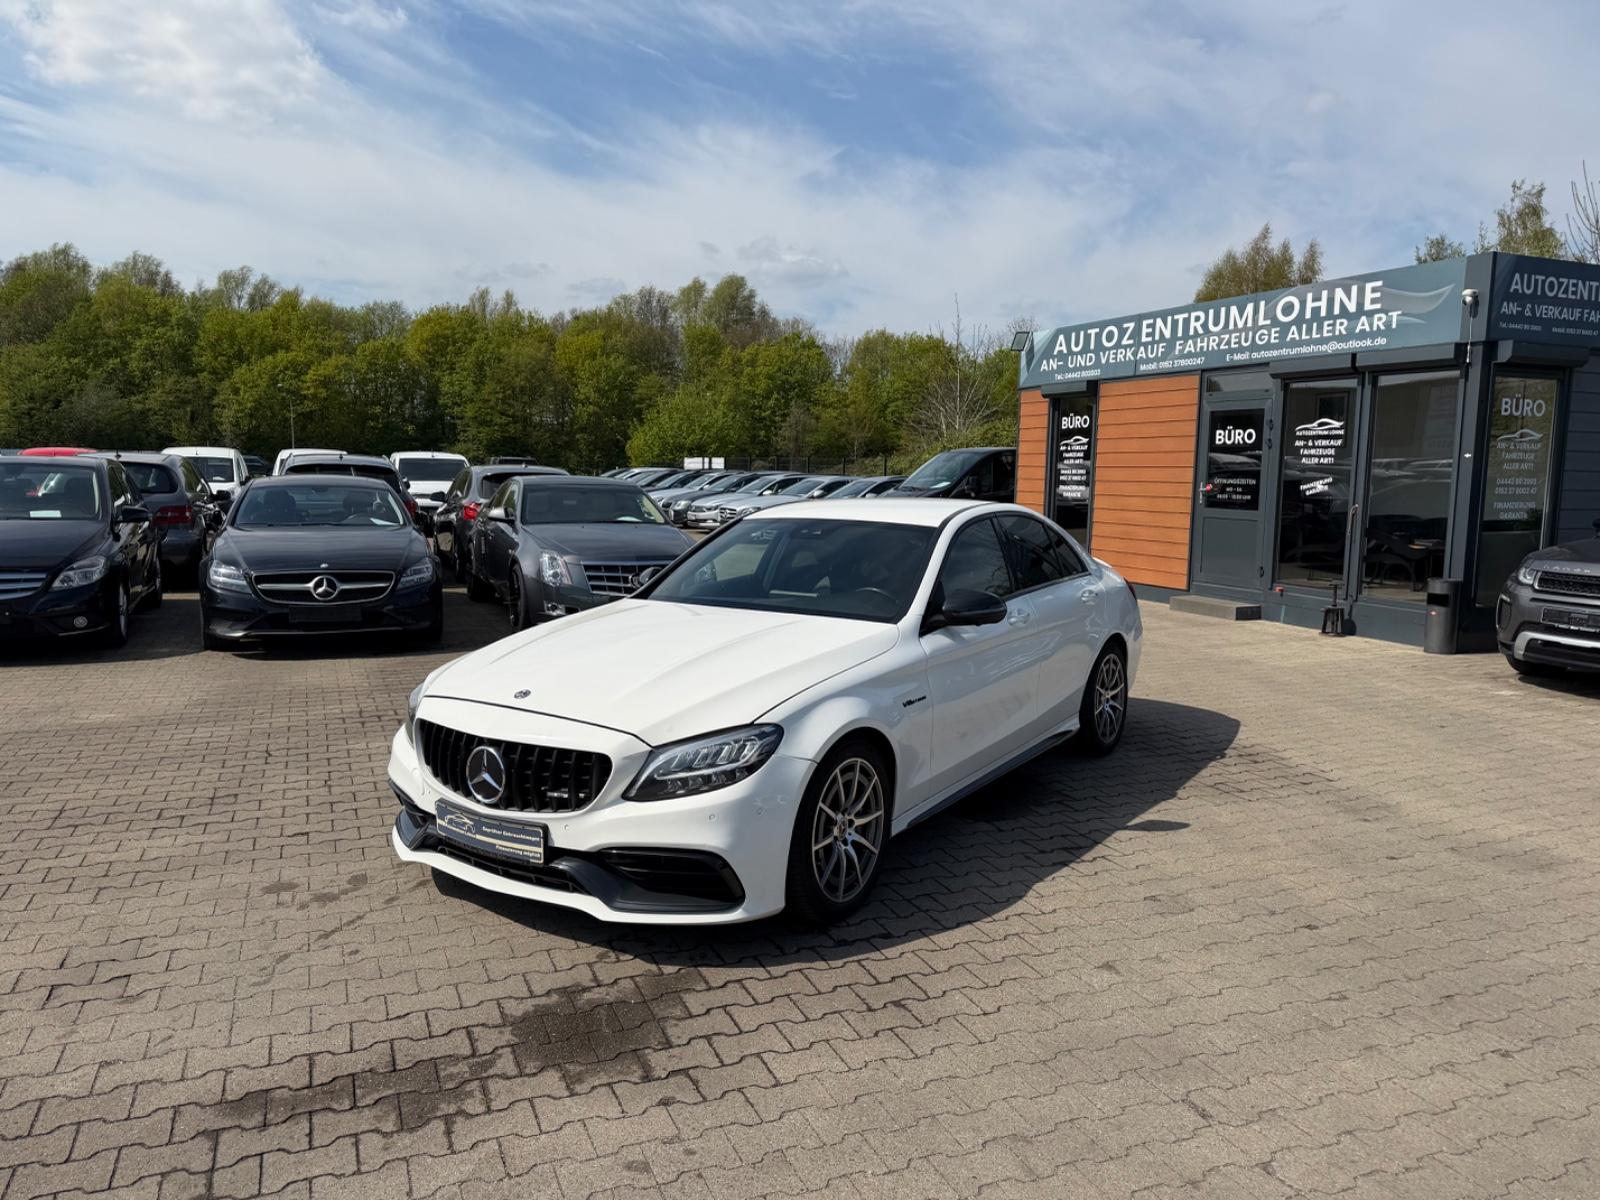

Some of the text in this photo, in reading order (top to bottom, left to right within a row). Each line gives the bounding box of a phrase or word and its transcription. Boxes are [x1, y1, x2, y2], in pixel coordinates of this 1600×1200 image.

[1510, 272, 1600, 302] AUTOZENT
[1053, 280, 1383, 355] AUTOZENTRUMLOHNE
[1500, 301, 1522, 316] AN-
[1524, 303, 1532, 317] &
[1534, 304, 1582, 321] VERKAUF
[1040, 310, 1402, 372] AN- UND VERKAUF FAHRZEUGE ALLER ART
[1251, 337, 1387, 360] autozentrumlohne@outlook.de
[1501, 393, 1546, 417] BÜRO
[1061, 413, 1090, 429] BÜRO
[1215, 425, 1256, 445] BÜRO
[1313, 439, 1343, 447] VERKAUF
